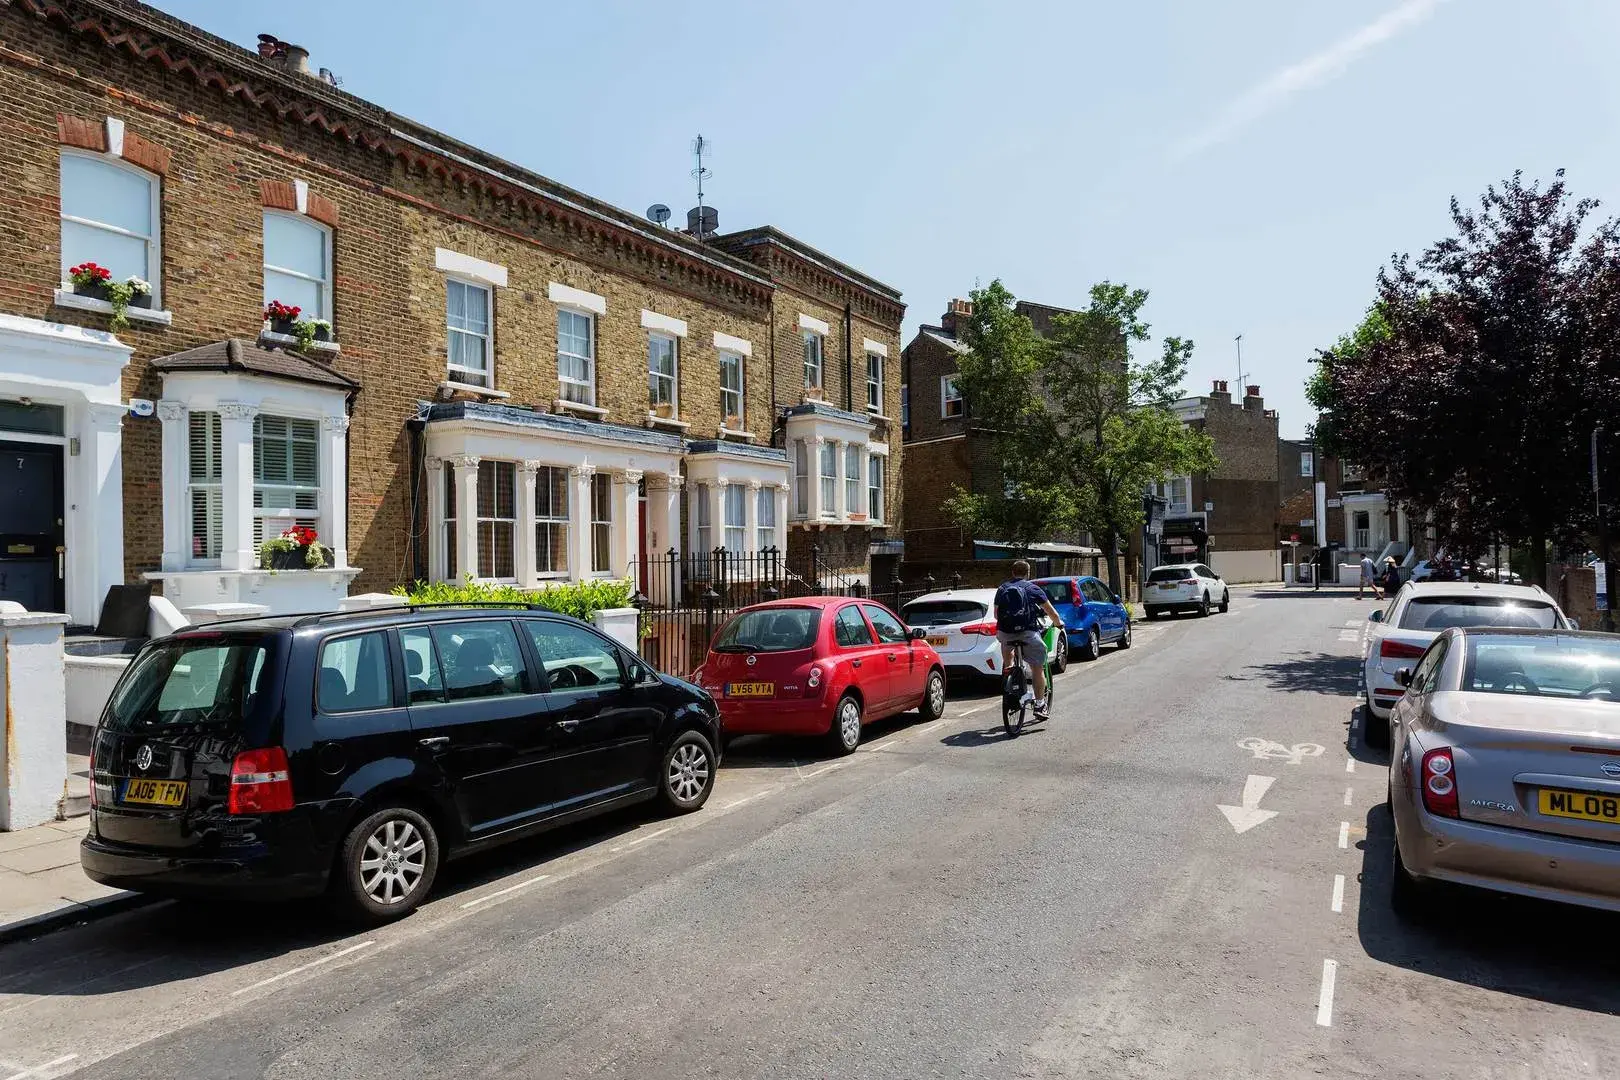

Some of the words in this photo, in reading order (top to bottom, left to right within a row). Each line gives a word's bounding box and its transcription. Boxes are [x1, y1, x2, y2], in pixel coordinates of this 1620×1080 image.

[16, 457, 24, 469] 7
[730, 684, 753, 694] LV56
[755, 683, 773, 694] VTA
[127, 781, 157, 799] LA06
[159, 783, 184, 802] TFN
[1471, 799, 1515, 812] MICRA
[1549, 792, 1618, 818] ML08
